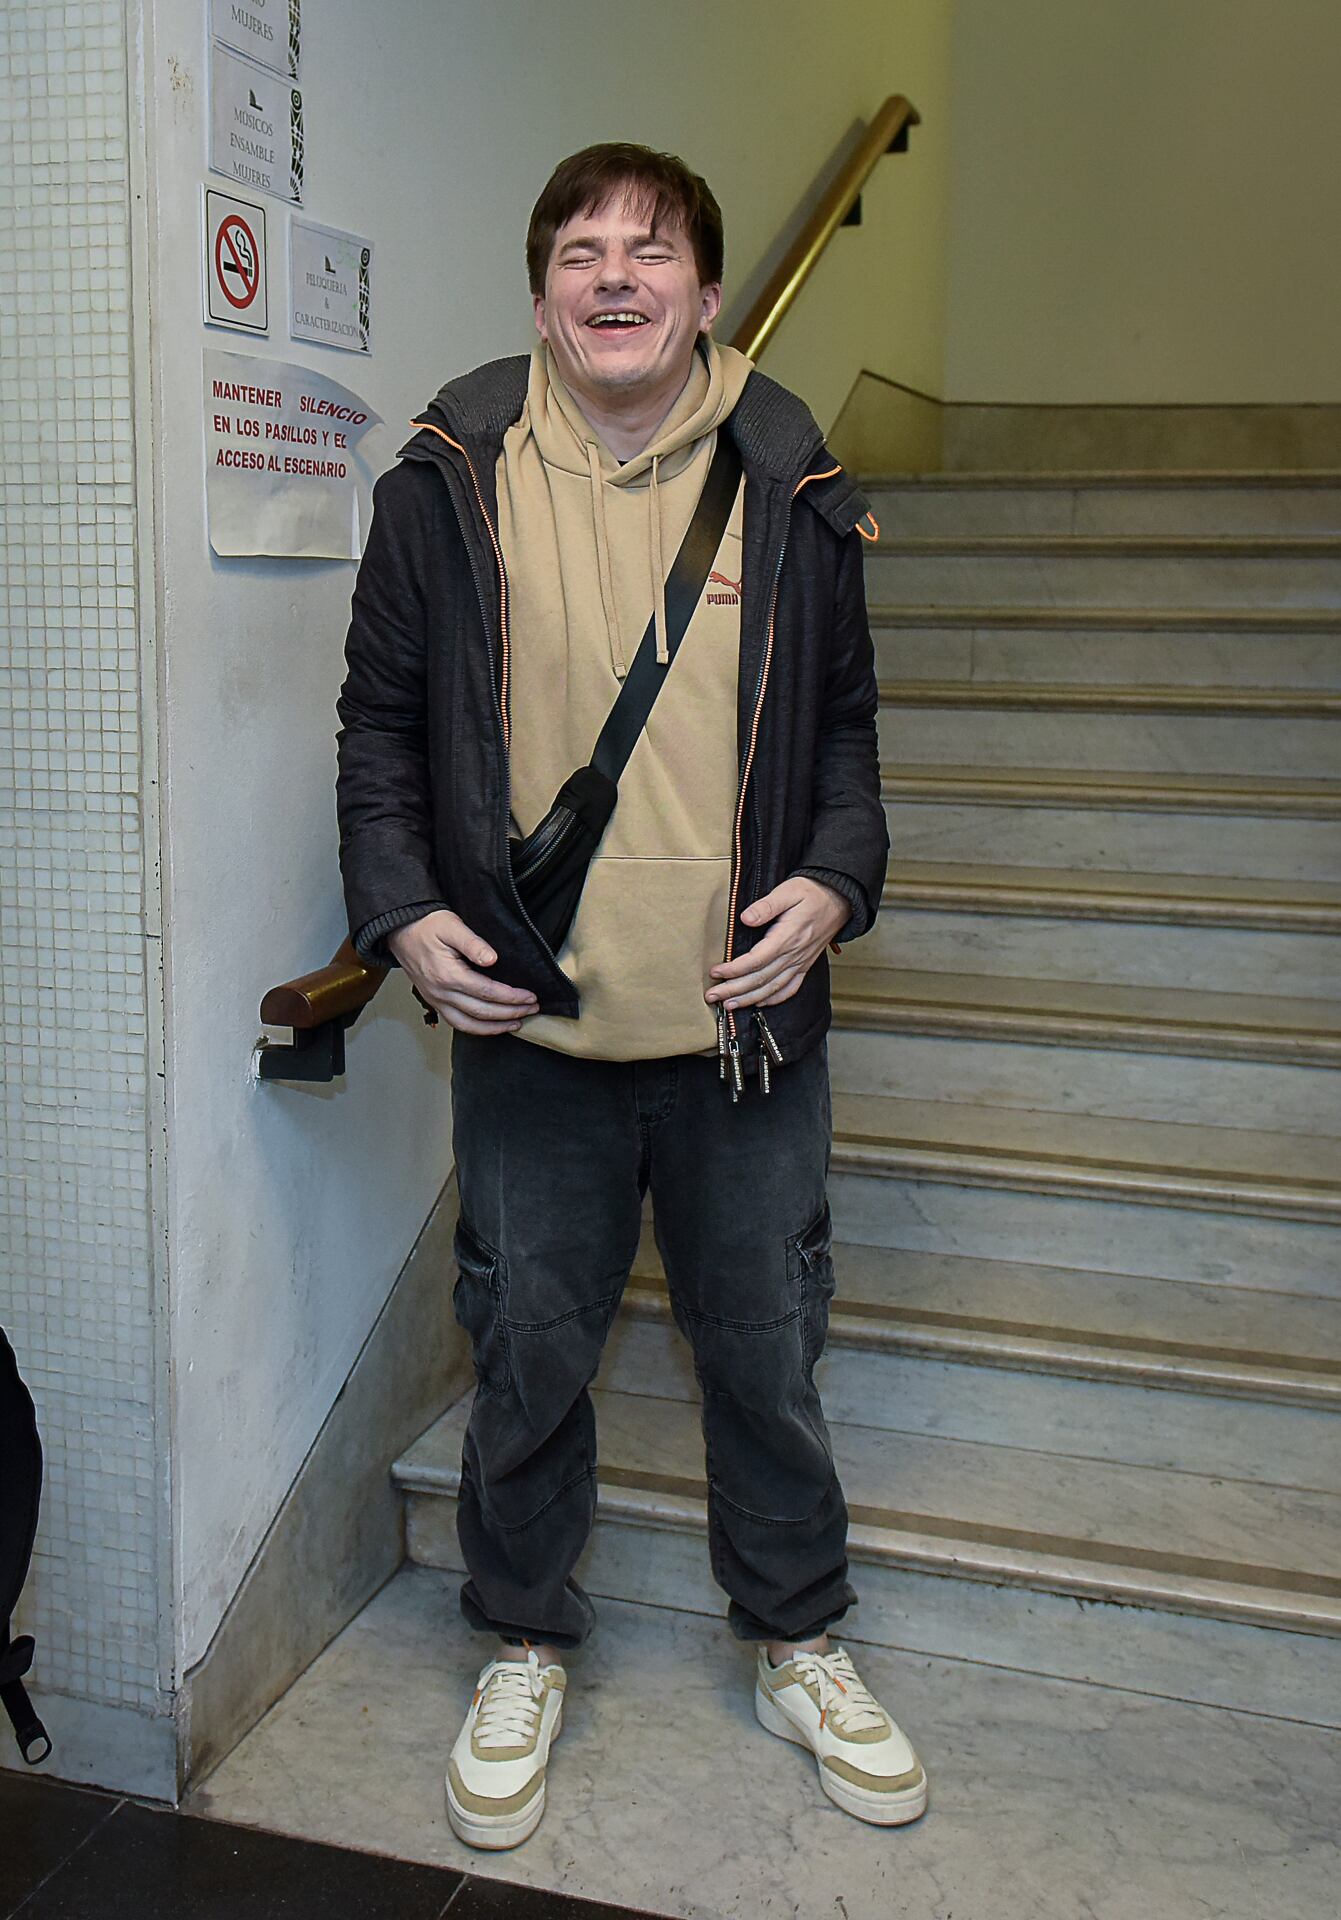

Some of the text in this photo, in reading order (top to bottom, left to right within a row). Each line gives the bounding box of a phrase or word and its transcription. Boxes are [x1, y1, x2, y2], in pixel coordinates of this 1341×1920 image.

[232, 4, 273, 41] MUJERES
[230, 132, 274, 164] ENSAMBLE
[233, 160, 271, 189] MUJERES
[212, 380, 368, 425] MANTENER SILENCIO
[213, 415, 347, 449] EN LOS PASILLOS Y EL
[216, 449, 347, 478] ACCESO AL ESCENARIO
[706, 593, 739, 605] PUMA
[766, 1031, 784, 1062] SUPERDRY
[733, 1058, 742, 1090] SUPERDRY
